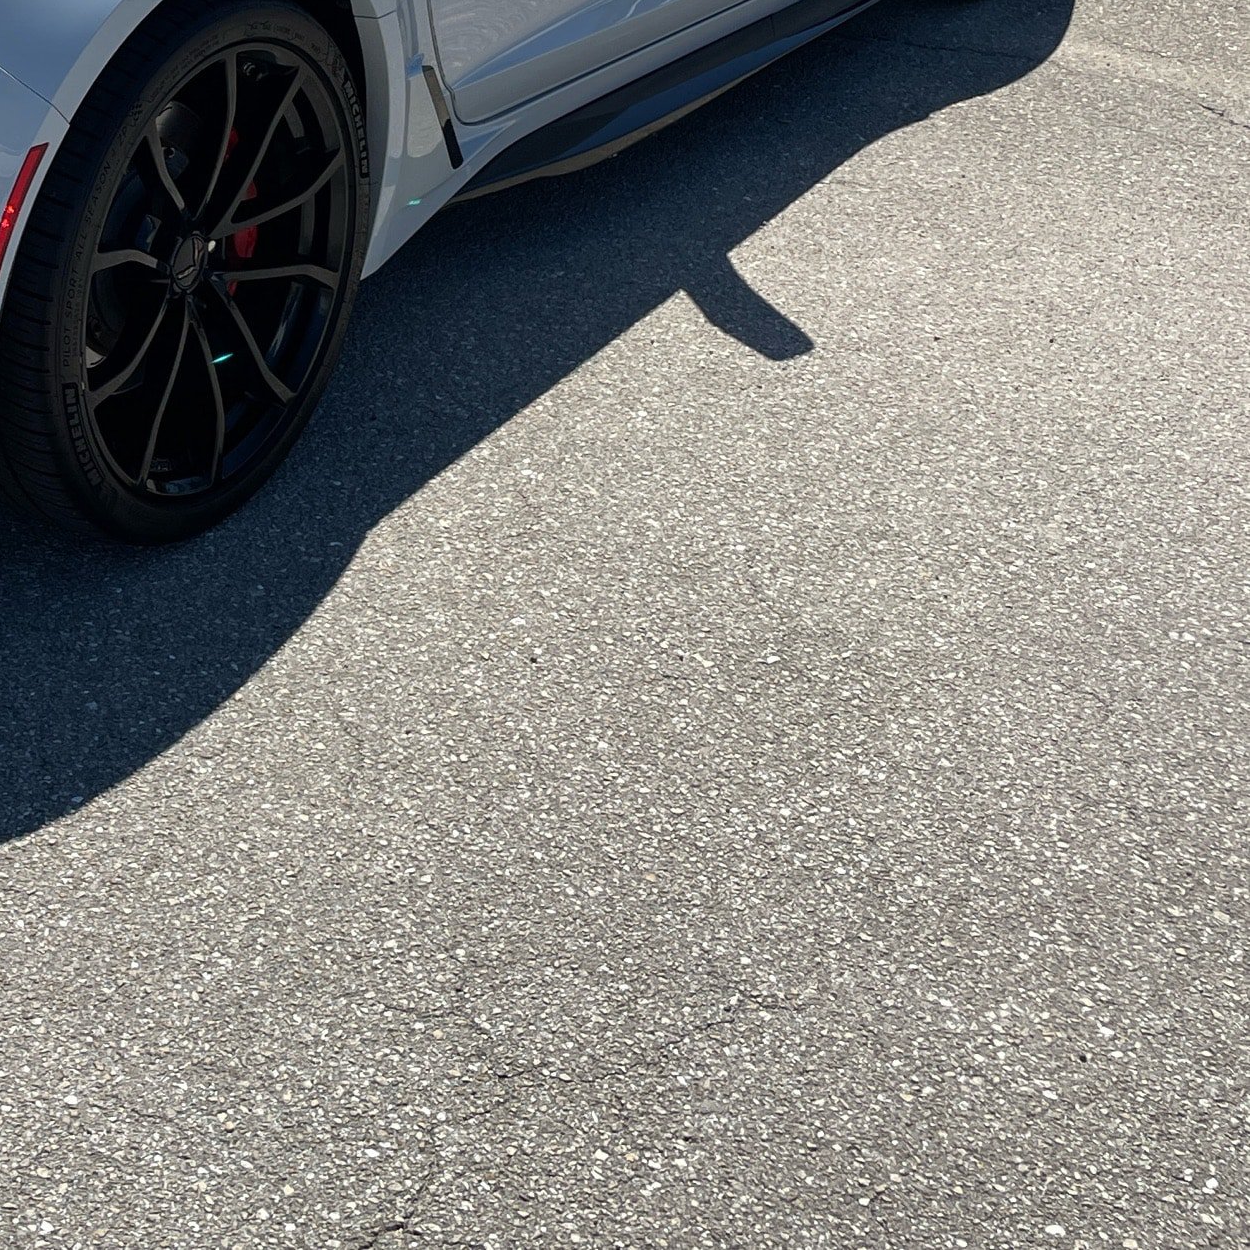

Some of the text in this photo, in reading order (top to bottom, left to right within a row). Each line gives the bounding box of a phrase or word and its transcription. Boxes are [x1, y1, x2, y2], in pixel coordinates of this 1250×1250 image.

[343, 79, 369, 175] MICHELIN
[85, 162, 111, 224] SEASON
[76, 232, 88, 261] ALL
[65, 267, 78, 319] SPORT
[63, 327, 72, 368] PILOT
[63, 386, 102, 486] MICHELIN
